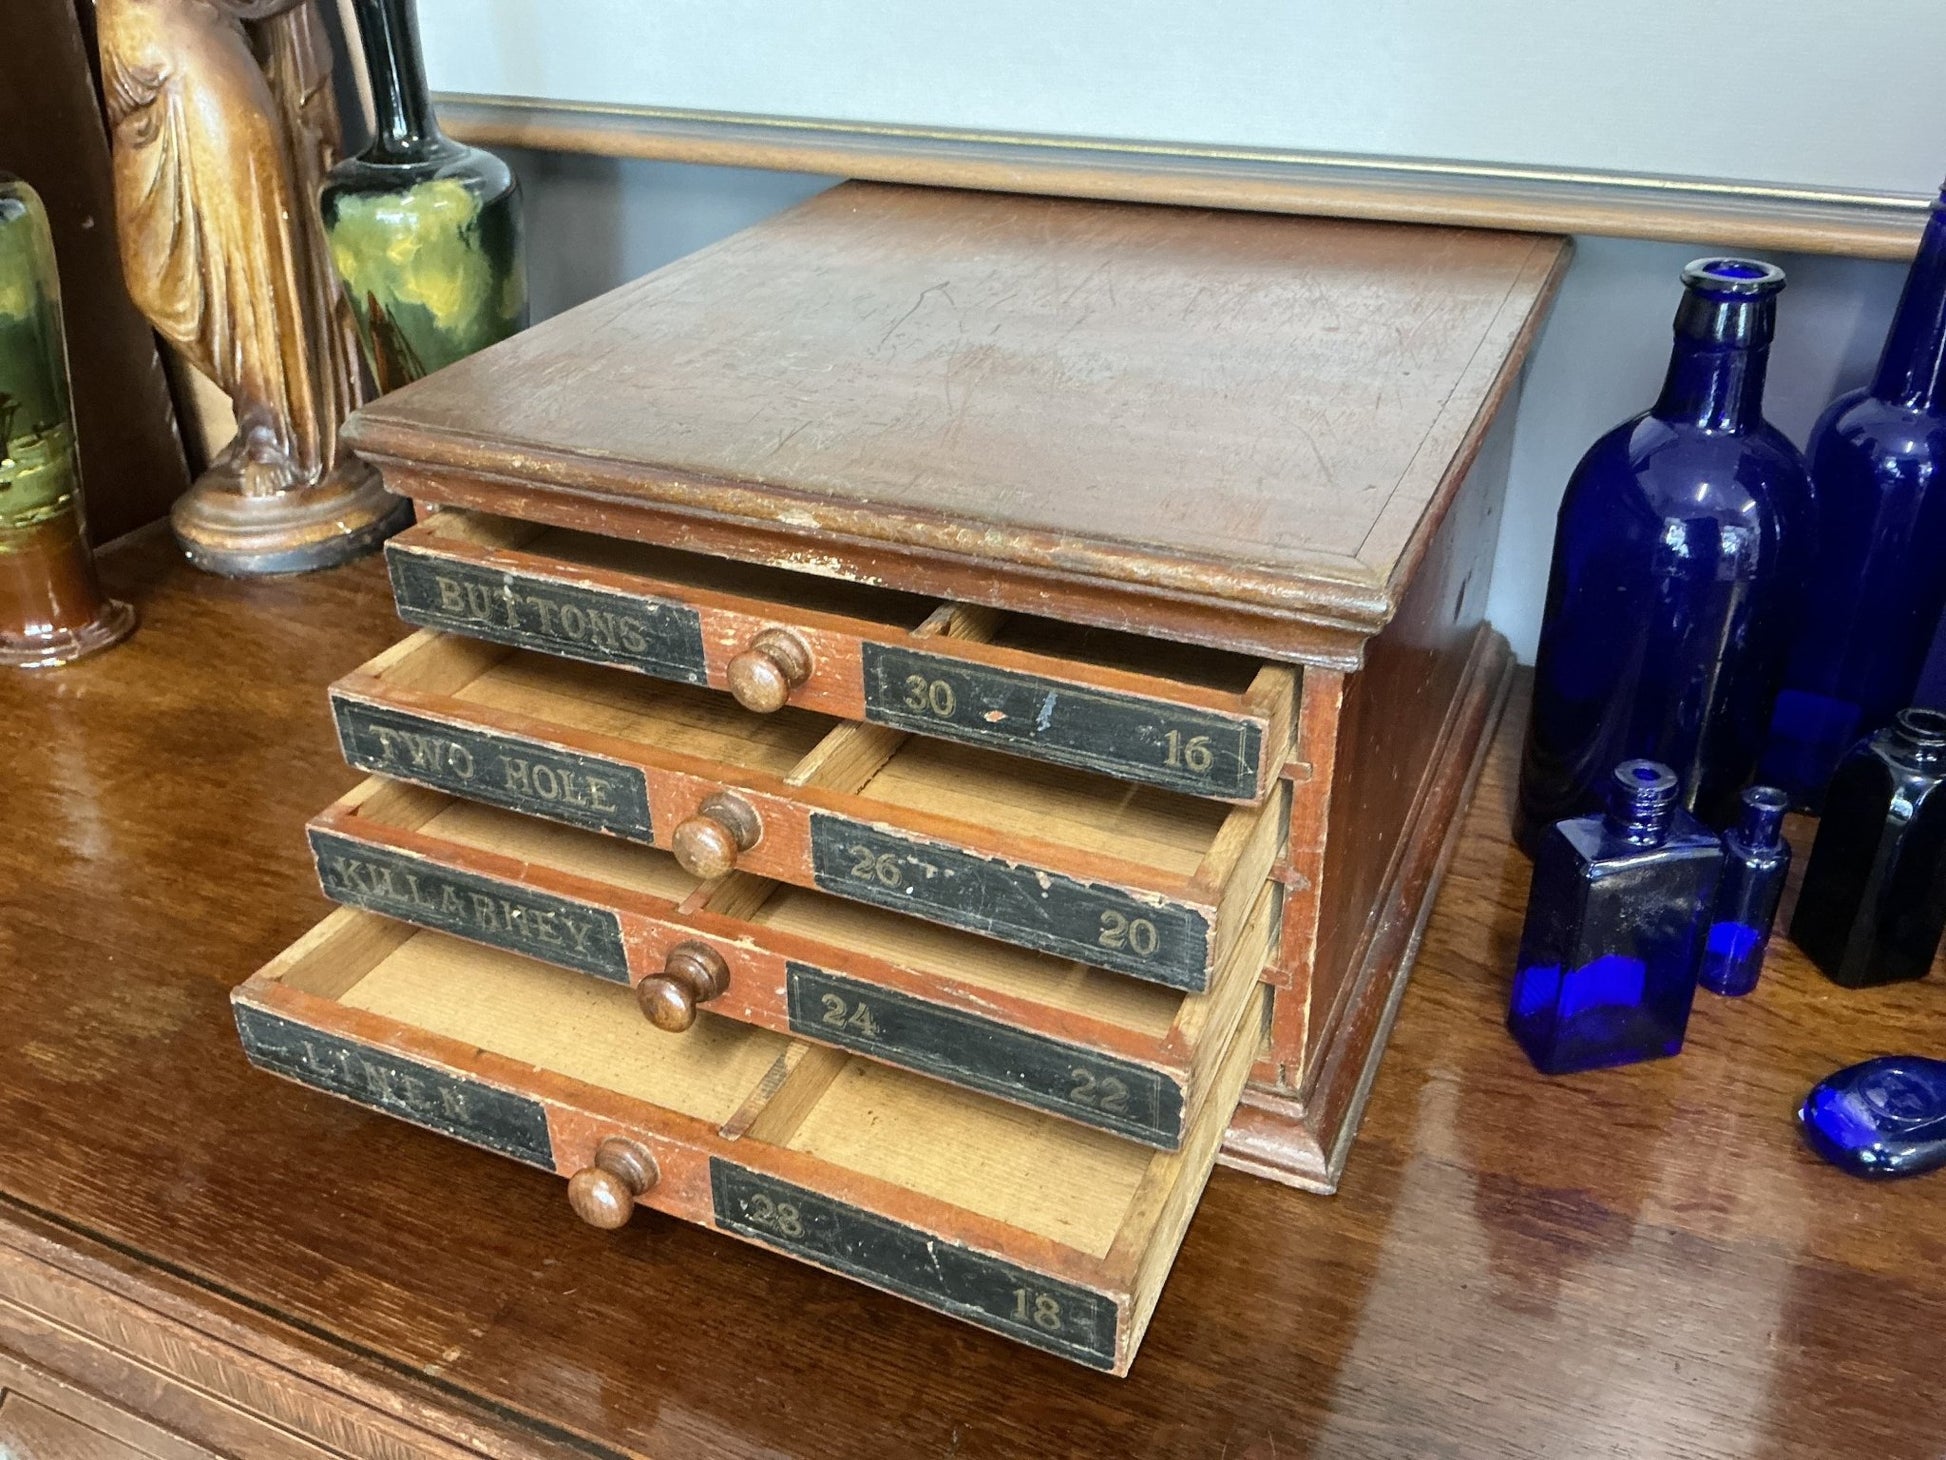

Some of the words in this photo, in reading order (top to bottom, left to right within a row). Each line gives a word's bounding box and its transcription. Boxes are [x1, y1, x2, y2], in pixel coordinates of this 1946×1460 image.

[436, 575, 648, 653] BUTTONS
[368, 723, 476, 780] TWO
[501, 754, 618, 814] HOLE
[904, 673, 957, 719] 30
[1163, 729, 1214, 774] 16
[848, 845, 903, 888] 26
[1098, 908, 1160, 958] 20
[302, 1040, 474, 1125] LINEN
[820, 993, 880, 1038] 24
[1070, 1067, 1132, 1115] 22
[750, 1192, 805, 1239] 28
[1010, 1286, 1064, 1331] 18
